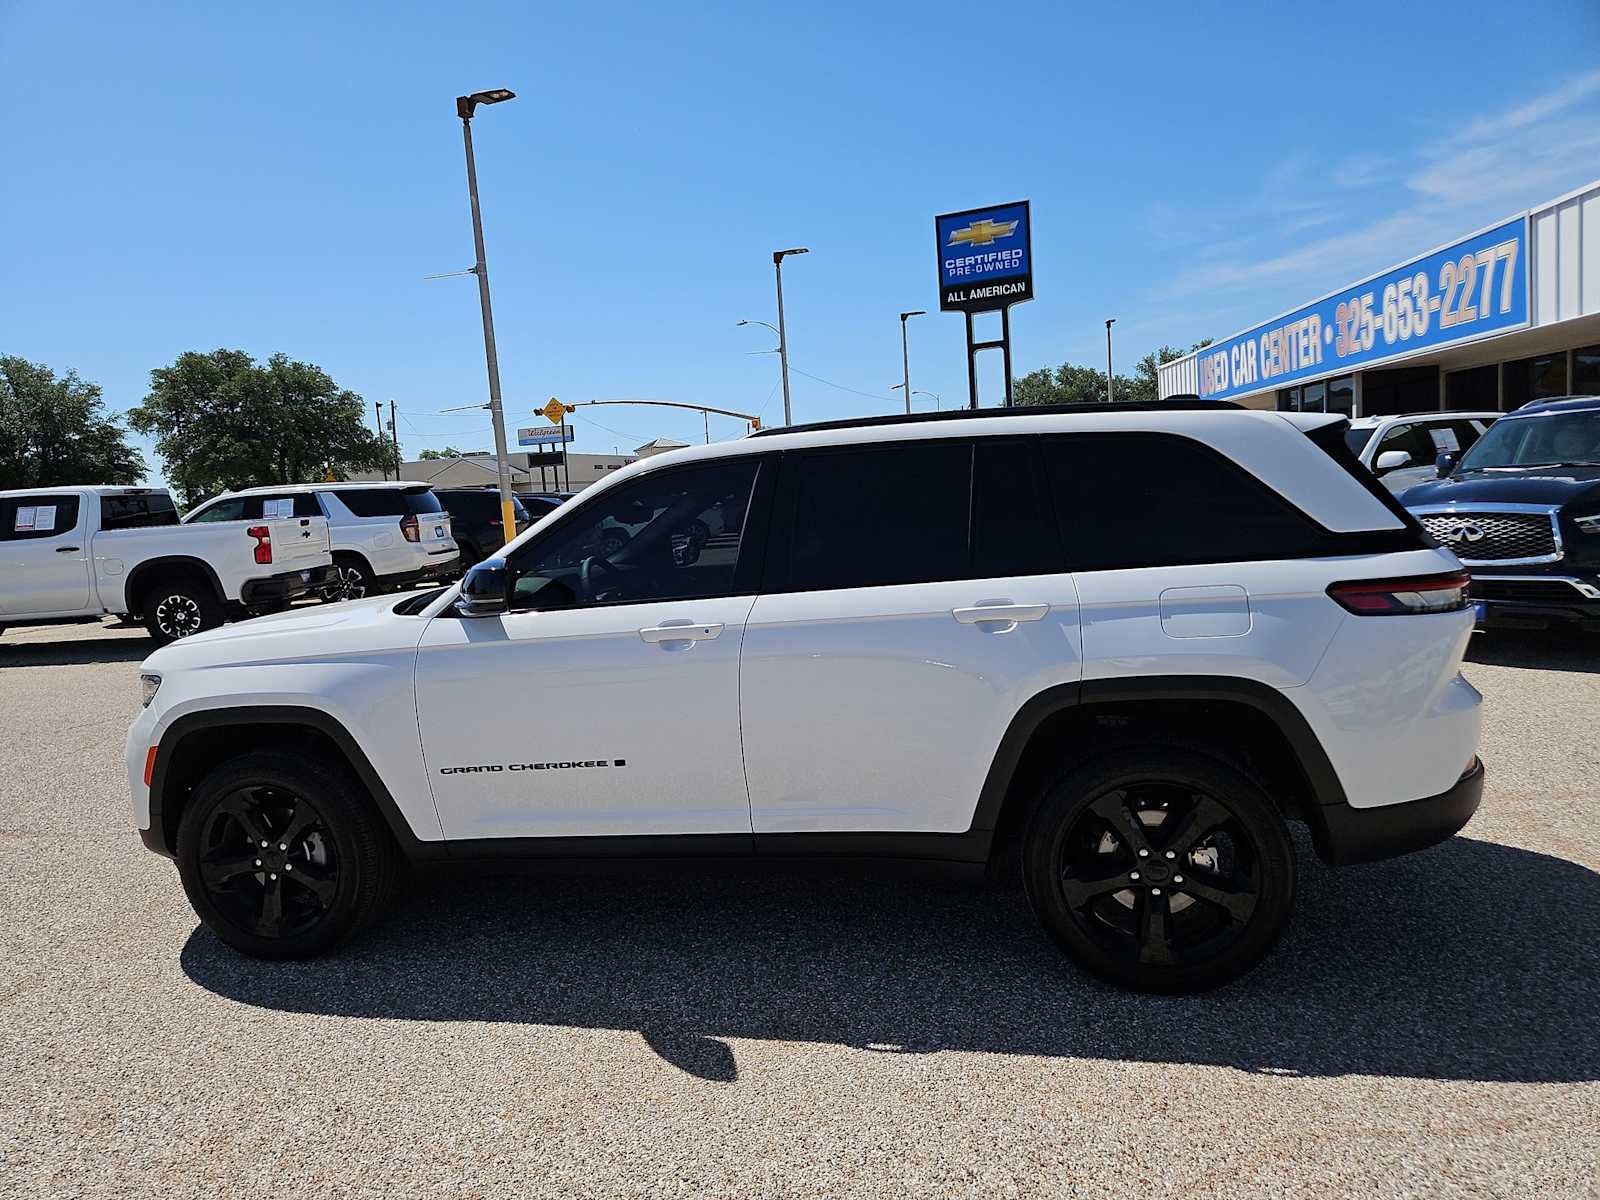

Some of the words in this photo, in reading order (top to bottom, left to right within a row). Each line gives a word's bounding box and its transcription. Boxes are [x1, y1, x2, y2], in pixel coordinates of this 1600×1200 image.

[945, 249, 1022, 269] CERTIFIED
[949, 259, 1019, 277] PRE-OWNED
[947, 290, 968, 303] ALL
[969, 281, 1025, 300] AMERICAN
[1199, 351, 1228, 396] USED
[1231, 338, 1258, 388] CAR
[1260, 314, 1322, 379] CENTER
[1335, 238, 1519, 358] 325-653-2277
[440, 764, 503, 775] GRAND
[508, 760, 608, 771] CHEROKEE
